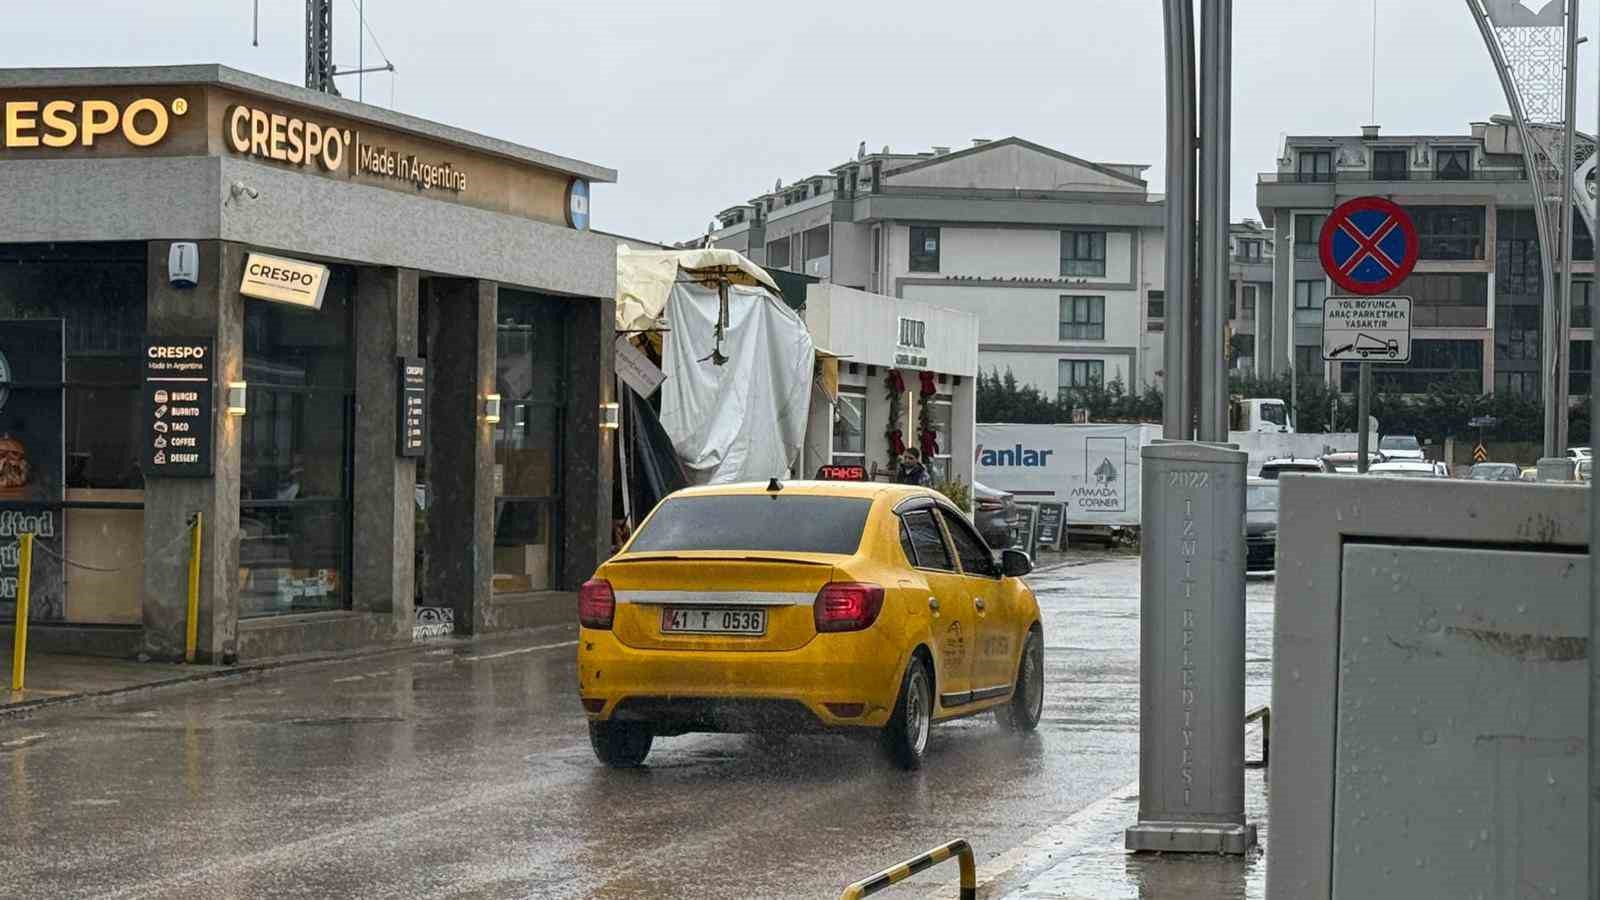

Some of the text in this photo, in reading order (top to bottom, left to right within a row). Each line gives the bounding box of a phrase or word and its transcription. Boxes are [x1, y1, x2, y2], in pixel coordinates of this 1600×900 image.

[361, 145, 396, 176] Made
[397, 153, 409, 176] In
[410, 156, 466, 191] Argentina
[249, 263, 313, 286] CRESPO
[1338, 300, 1397, 309] YOL BOYUNCA
[1345, 320, 1388, 328] YASAKTIR
[147, 346, 204, 358] CRESPO
[173, 362, 203, 371] Argentina
[171, 392, 198, 401] BURGER
[171, 407, 200, 416] BURRITO
[171, 422, 189, 431] TACO
[170, 437, 196, 447] COFFEE
[170, 453, 199, 463] DESSERT
[1168, 469, 1209, 489] 2022
[1071, 487, 1118, 498] ARMADA
[1078, 498, 1119, 507] CORNER
[672, 611, 761, 630] 41 T 0536
